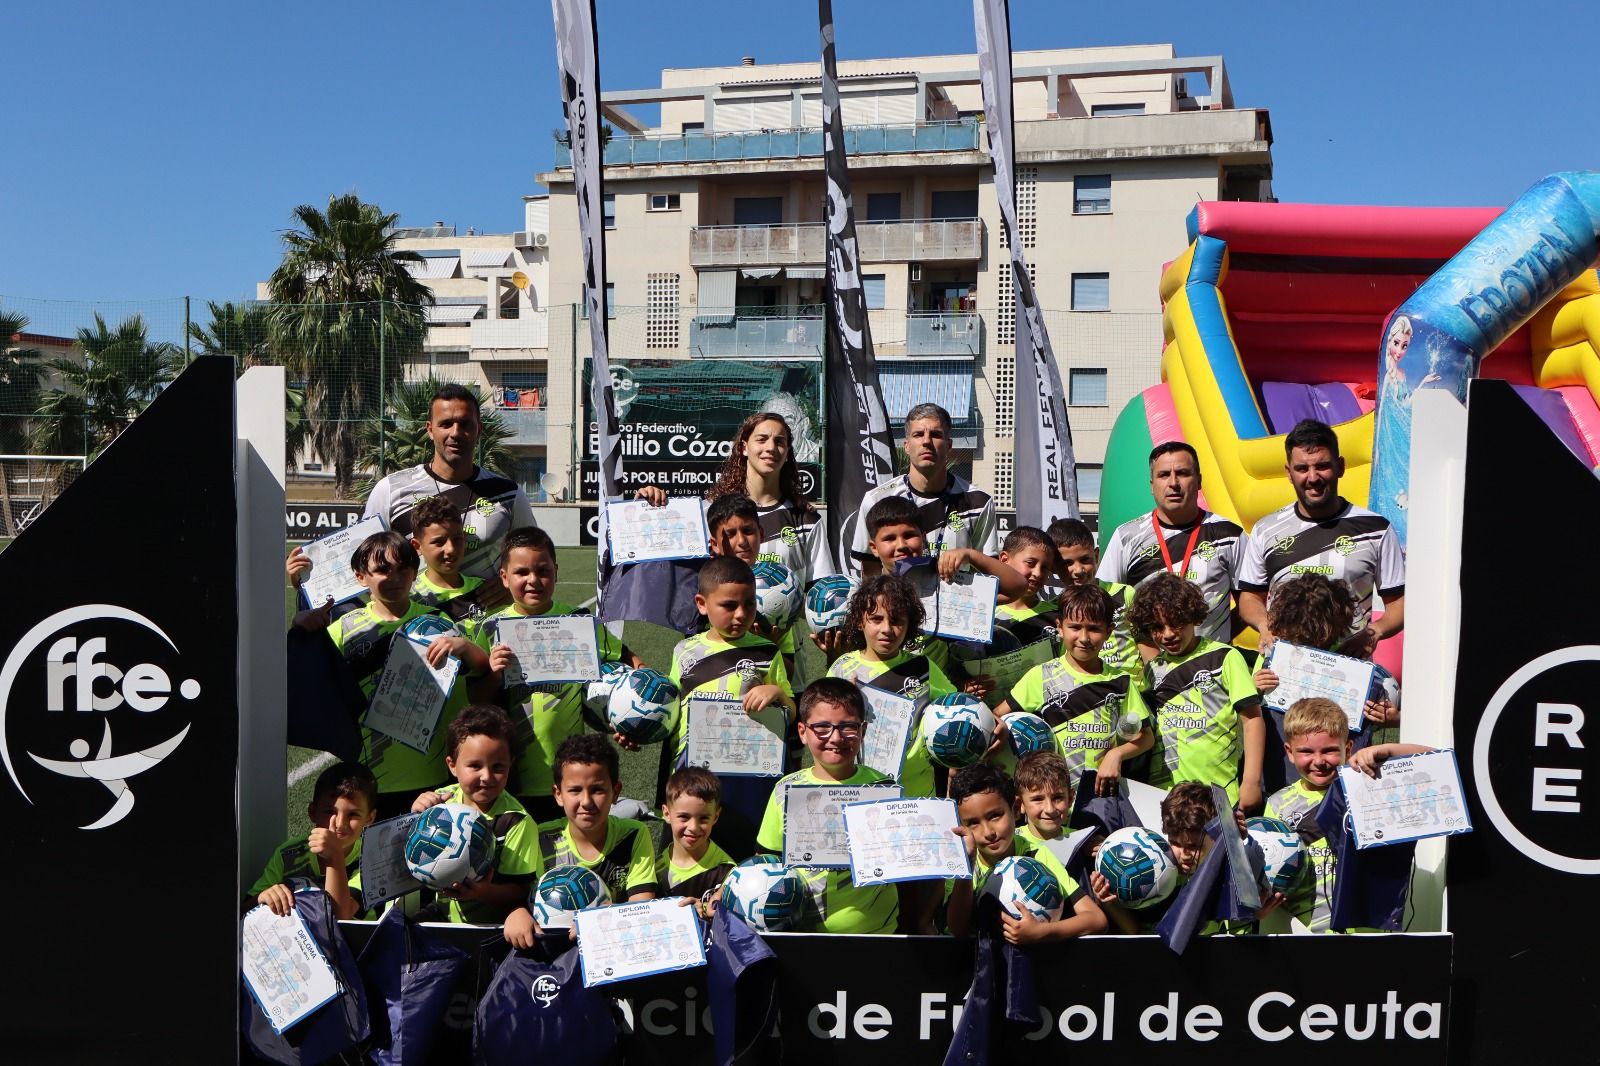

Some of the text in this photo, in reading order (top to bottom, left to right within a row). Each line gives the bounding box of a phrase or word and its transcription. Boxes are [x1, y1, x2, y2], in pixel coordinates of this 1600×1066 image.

[636, 422, 696, 433] Federativo
[589, 432, 735, 457] Eilio Cóza
[860, 422, 876, 485] REAL
[584, 472, 629, 483] JUS
[631, 472, 656, 483] POR
[658, 472, 670, 483] EL
[672, 468, 713, 483] FÚTBOL
[1045, 438, 1060, 500] REAL
[316, 512, 341, 528] AL
[1290, 565, 1334, 575] Escuela
[532, 618, 561, 626] DIPLOMA
[1309, 651, 1338, 664] DIPLOMA
[1067, 721, 1109, 733] Escuela
[1534, 702, 1585, 749] R
[1064, 737, 1111, 749] de Fútbol
[1380, 759, 1414, 771] DIPLOMA
[1531, 767, 1582, 813] E
[886, 803, 919, 811] DIPLOMA
[618, 904, 651, 914] DIPLOMA
[297, 929, 318, 960] DIPLOMA
[807, 990, 893, 1041] de
[1138, 991, 1224, 1042] de
[1247, 990, 1442, 1042] Ceuta
